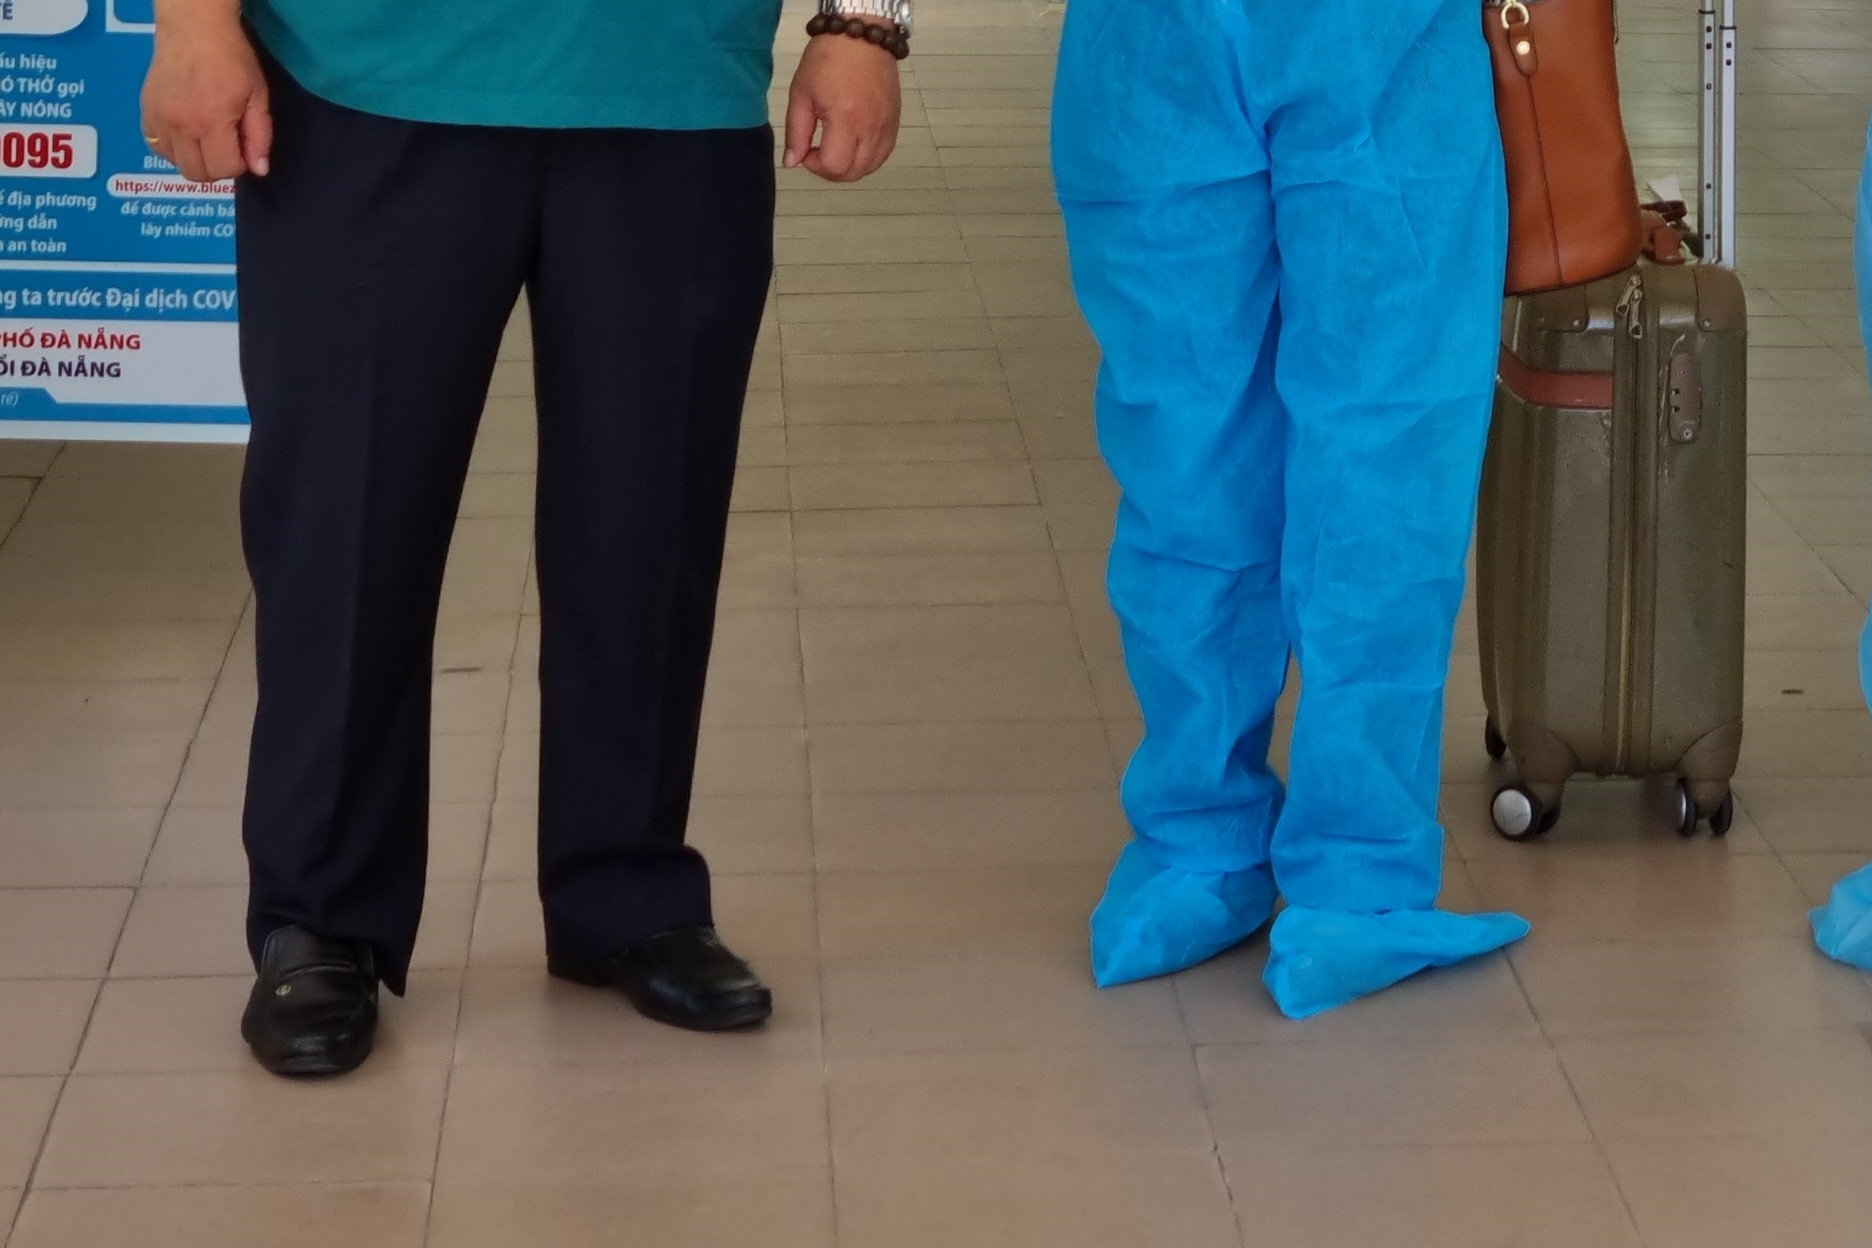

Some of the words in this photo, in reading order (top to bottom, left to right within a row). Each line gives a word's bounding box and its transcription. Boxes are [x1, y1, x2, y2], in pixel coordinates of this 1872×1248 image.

[20, 54, 56, 73] hiệu
[17, 75, 53, 93] THỞ
[58, 80, 84, 98] gọi
[21, 101, 72, 118] NÓNG
[8, 191, 30, 210] địa
[36, 193, 96, 211] phương
[142, 202, 176, 218] được
[28, 215, 56, 229] dẫn
[141, 223, 161, 238] lây
[165, 223, 210, 236] nhiễm
[8, 242, 26, 252] an
[31, 240, 67, 253] toàn
[22, 289, 42, 305] ta
[47, 287, 101, 306] trước
[106, 288, 140, 312] Đại
[145, 289, 187, 314] dịch
[41, 330, 70, 349] ĐÀ
[78, 327, 141, 349] NẴNG
[21, 357, 51, 377] ĐÀ
[58, 354, 121, 377] NẴNG
